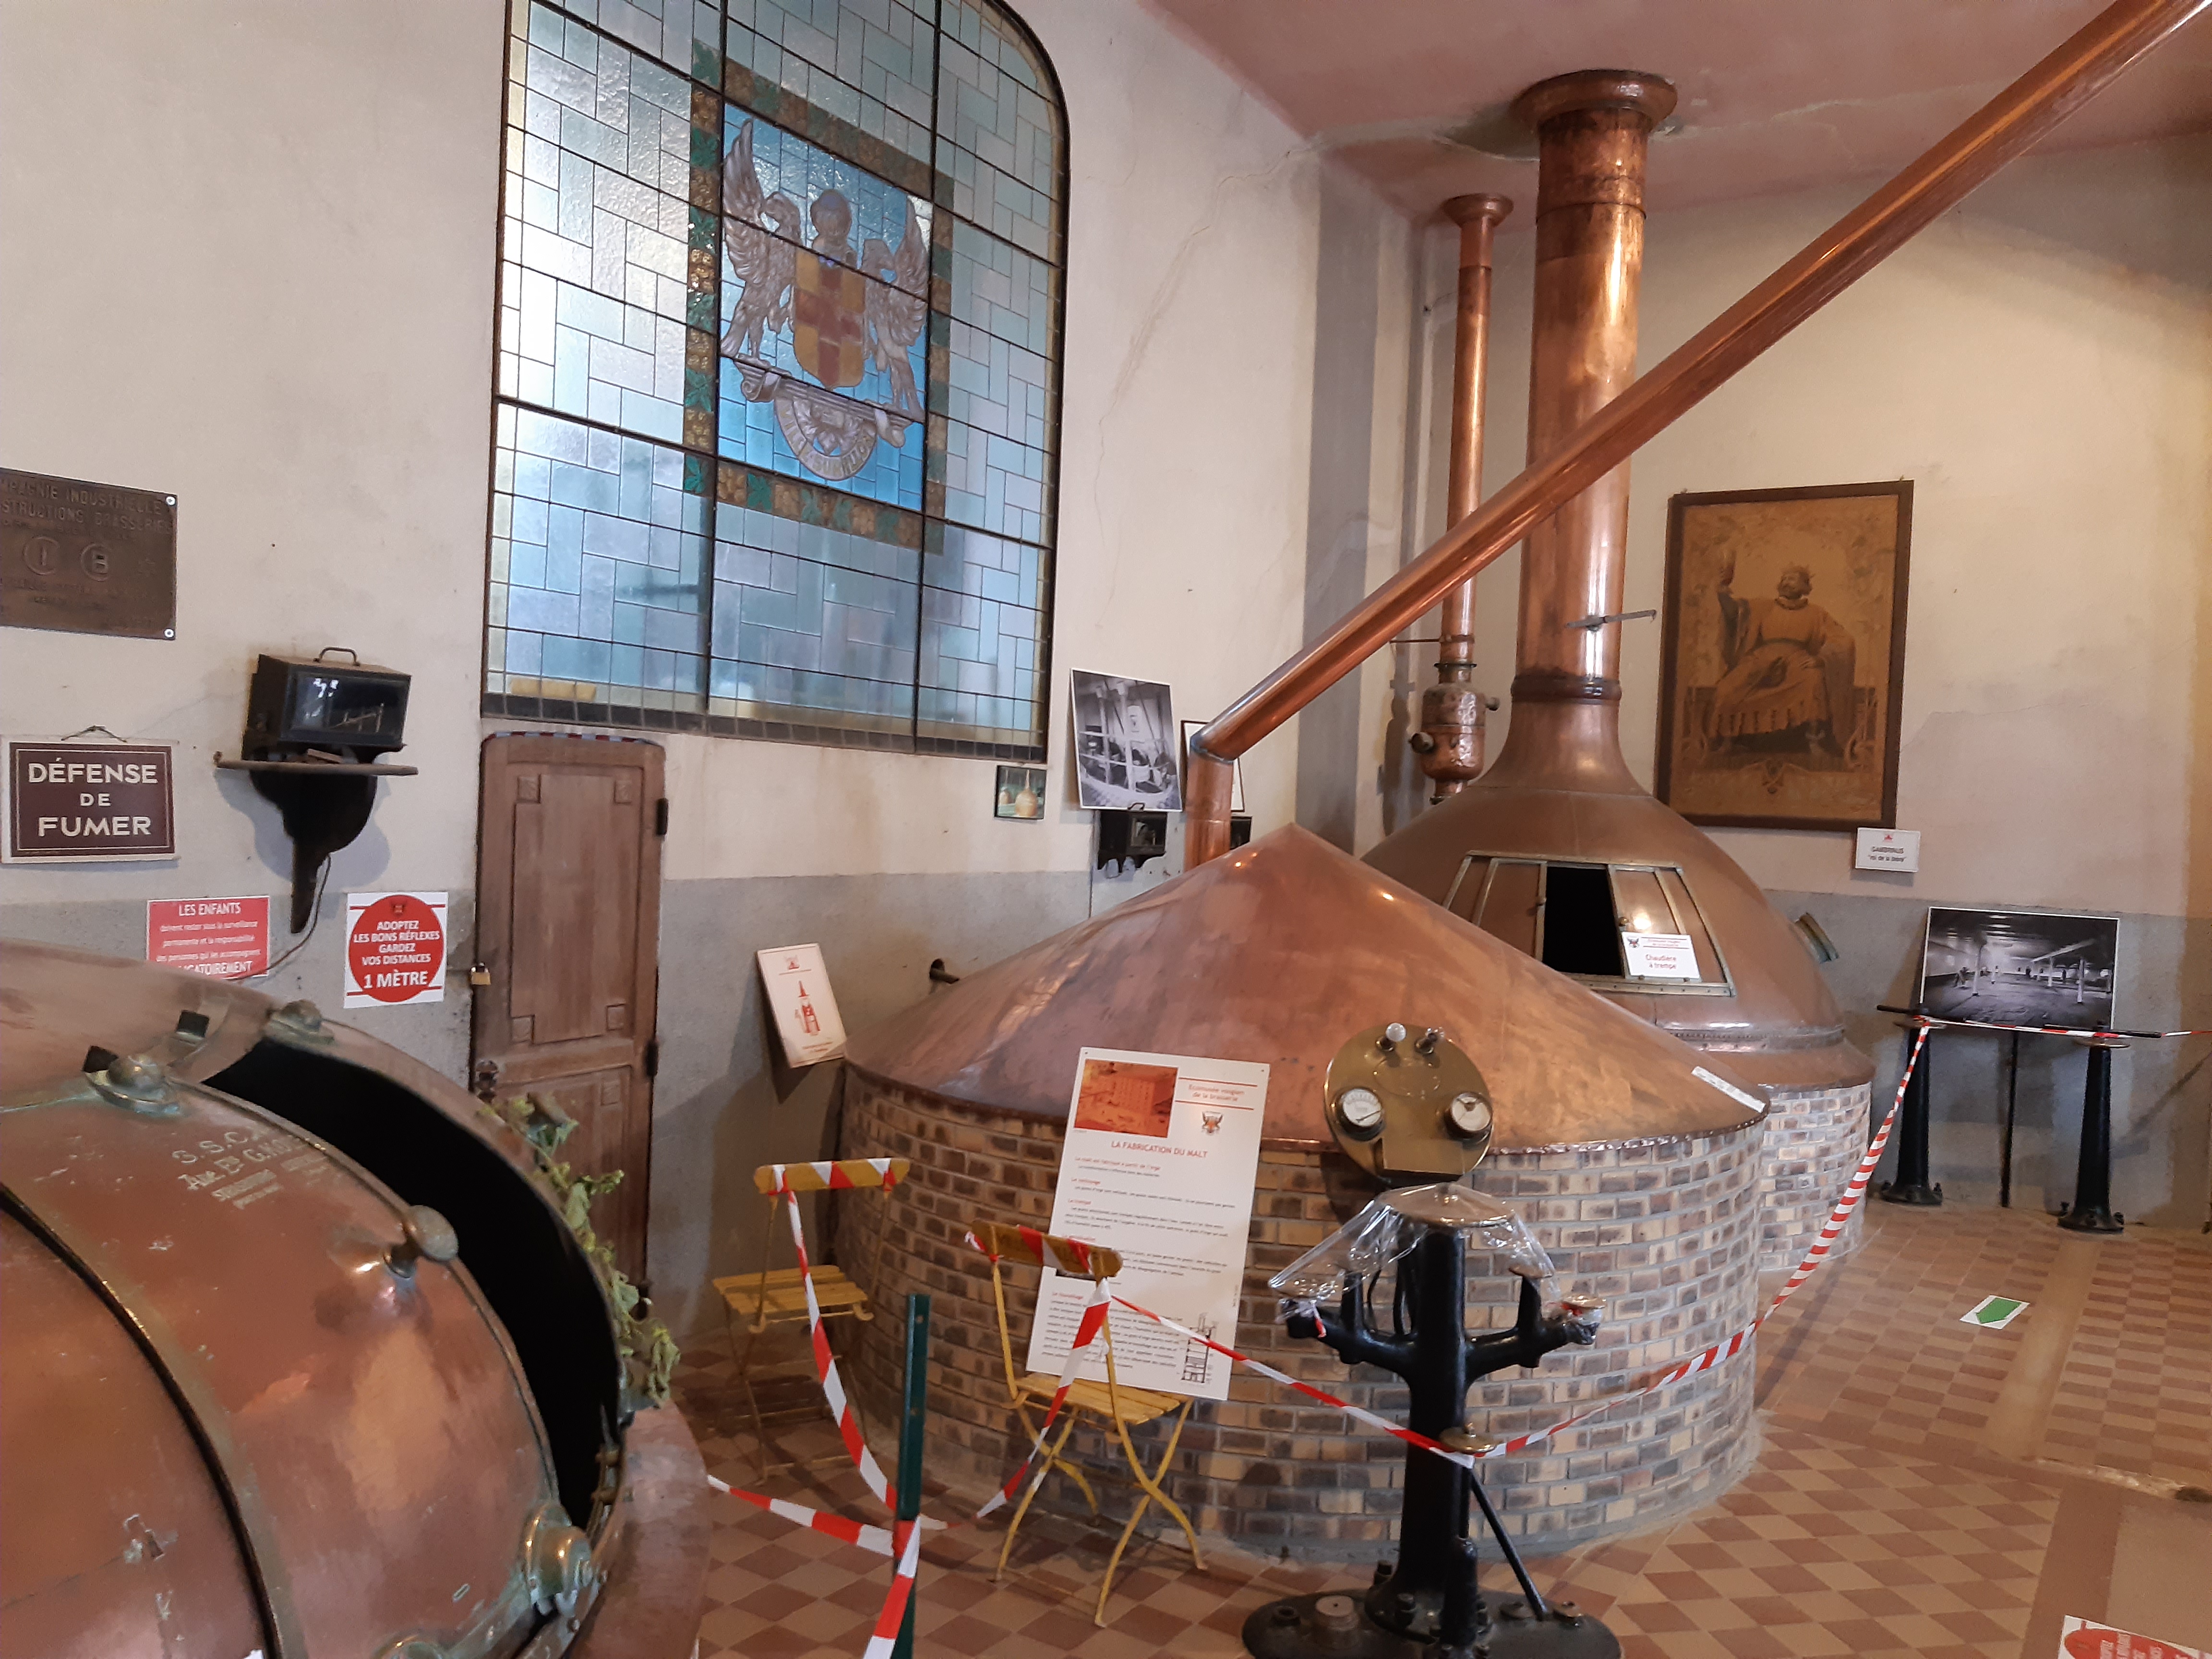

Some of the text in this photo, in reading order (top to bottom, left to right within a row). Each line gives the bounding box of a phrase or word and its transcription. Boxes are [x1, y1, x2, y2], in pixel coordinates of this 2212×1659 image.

[28, 757, 158, 783] DÉFENSE
[80, 793, 111, 806] DE
[37, 816, 151, 837] FUMER
[179, 902, 241, 916] LES ENFANTS
[376, 920, 419, 930] ADOPTEZ
[353, 930, 440, 943] LES BONS RÉFLEXES
[379, 942, 416, 953] GARDEZ
[362, 953, 432, 966] VOS DISTANCES
[363, 969, 428, 989] 1 MÈTRE
[1122, 1141, 1172, 1154] FABRICATION
[1187, 1149, 1208, 1158] MALT
